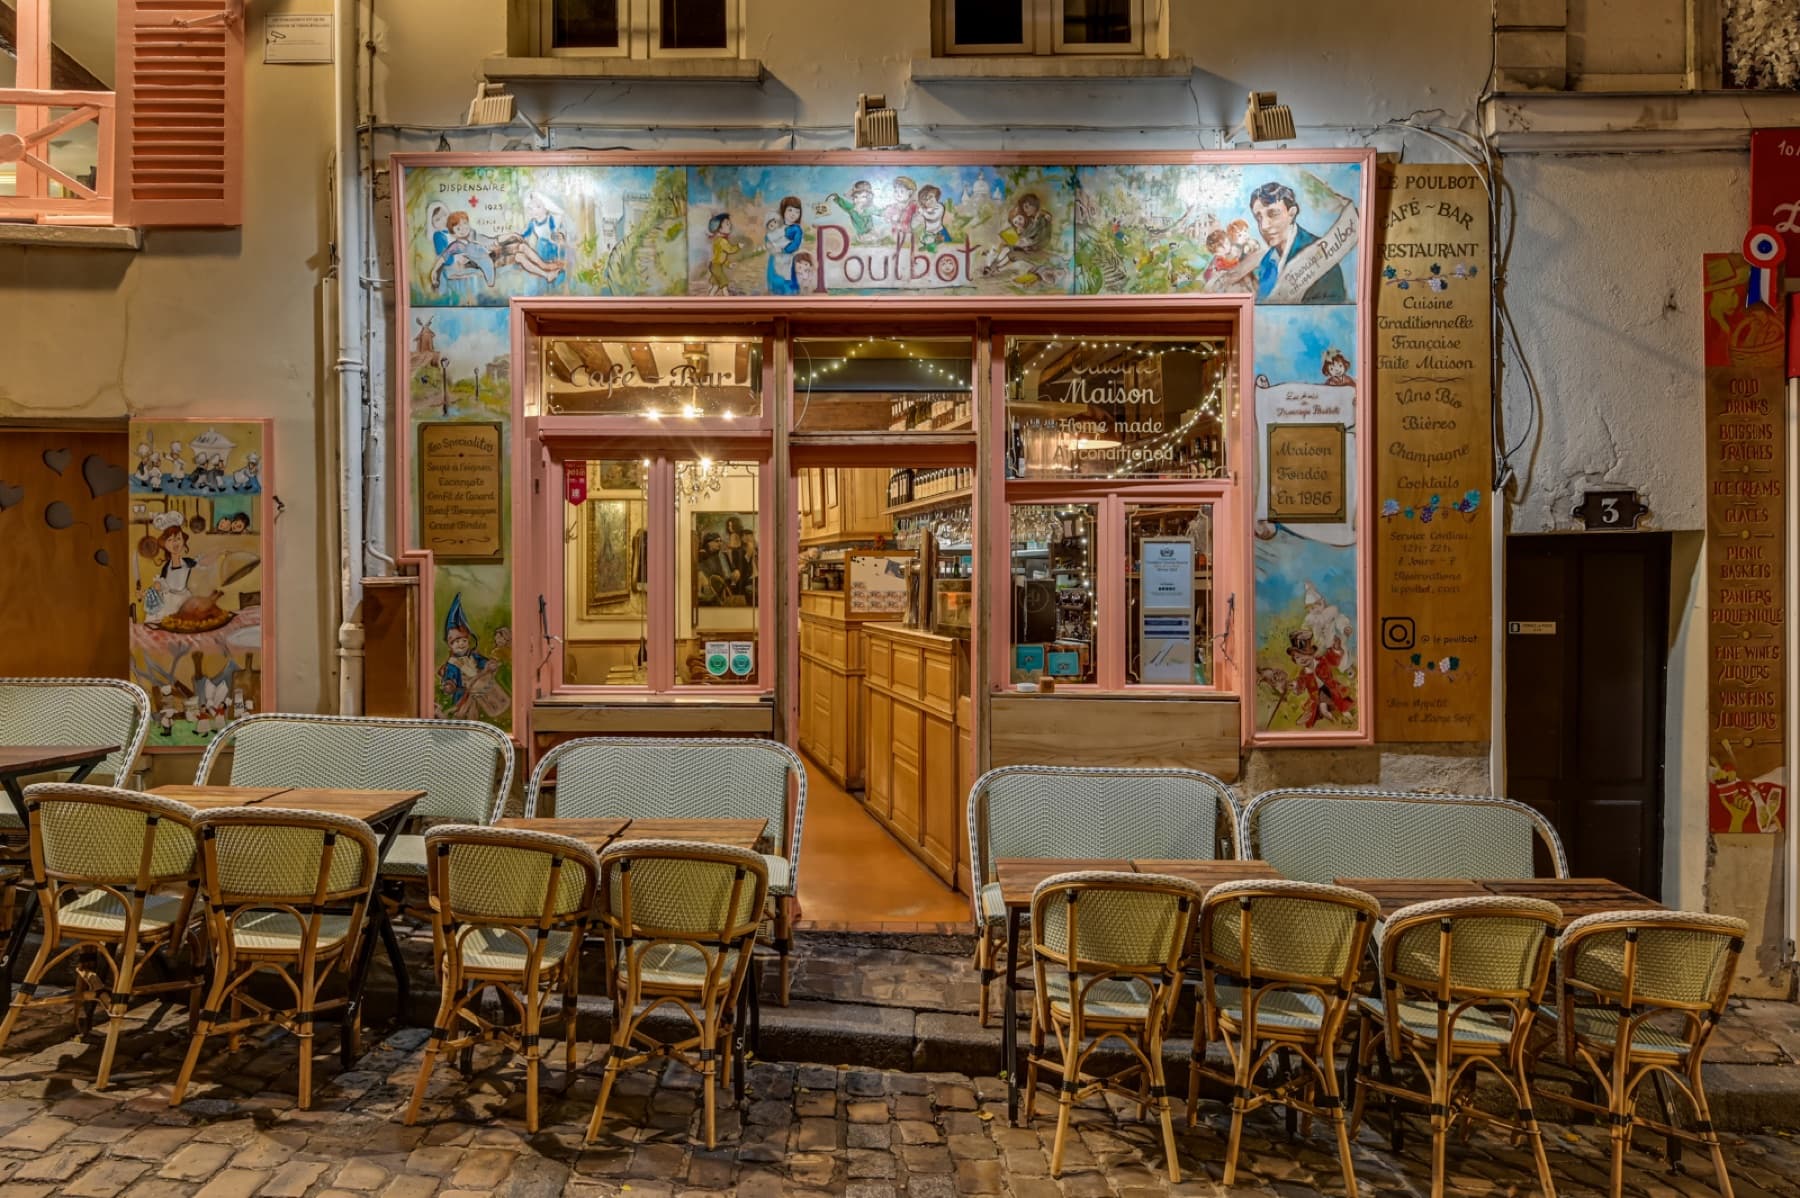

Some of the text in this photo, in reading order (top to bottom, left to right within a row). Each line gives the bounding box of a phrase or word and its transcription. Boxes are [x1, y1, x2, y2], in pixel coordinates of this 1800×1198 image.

[439, 183, 506, 193] DISPENSAIRE
[1405, 174, 1480, 190] POULBOT
[1437, 201, 1474, 231] BAR
[1317, 218, 1357, 261] Poulbot
[811, 223, 983, 294] Poulbot
[1376, 242, 1479, 260] RESTAURANT
[1402, 296, 1454, 310] Cuisine
[1376, 314, 1474, 330] Traditionnelle
[1391, 334, 1461, 352] Française
[1376, 354, 1474, 370] Faite Maison
[569, 363, 732, 399] Café Bar
[1729, 378, 1760, 398] COLD
[1060, 378, 1161, 405] Maison
[1435, 387, 1463, 409] Bio
[1719, 398, 1770, 416] DRINKS
[1059, 418, 1163, 434] Home made
[1402, 415, 1456, 431] Bières
[1720, 423, 1773, 440] BOISSONS
[1275, 442, 1333, 457] Maison
[1388, 441, 1471, 468] Champagne
[1276, 466, 1330, 481] Fondée
[1396, 475, 1460, 490] Cocktails
[1713, 480, 1782, 499] ICE CREAMS
[1276, 490, 1333, 506] En 1986
[1601, 497, 1620, 523] 3
[1725, 508, 1769, 523] GLACES
[1726, 545, 1764, 560] PICNIC
[1720, 563, 1772, 579] BASKETS
[1720, 588, 1773, 606] PANIERS
[1714, 644, 1781, 660] FINE WINES
[1719, 689, 1776, 706] VINS FINS
